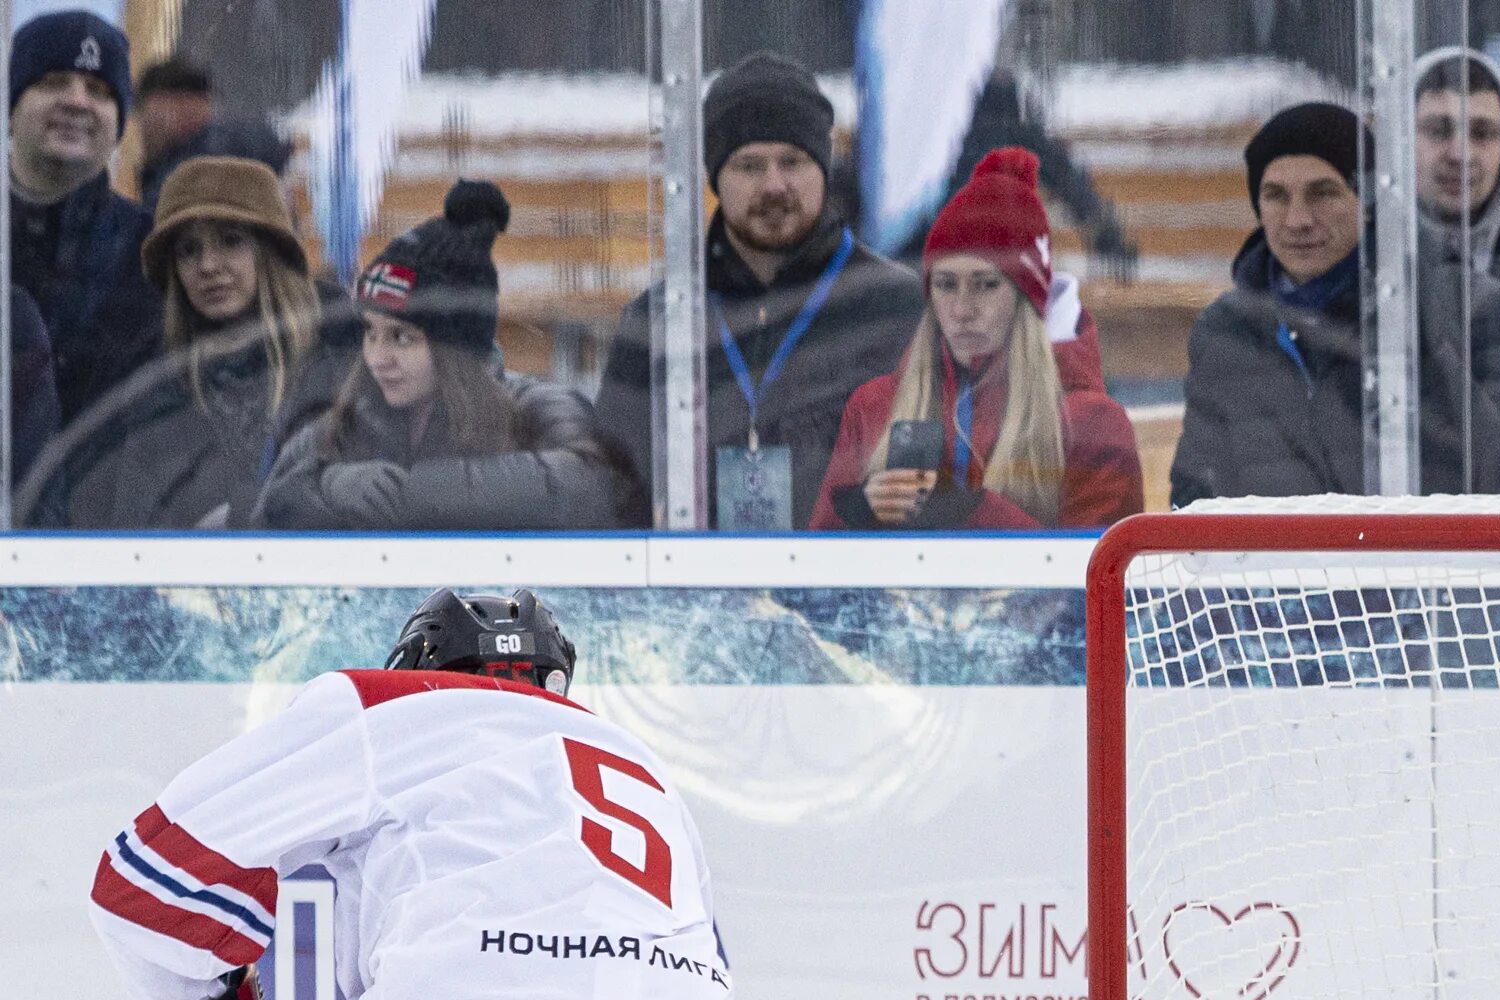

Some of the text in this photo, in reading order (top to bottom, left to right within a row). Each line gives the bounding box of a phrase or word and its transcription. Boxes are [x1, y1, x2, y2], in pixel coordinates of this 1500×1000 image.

[562, 737, 673, 910] 5
[480, 930, 729, 990] НОЧНАЯ ЛИГА
